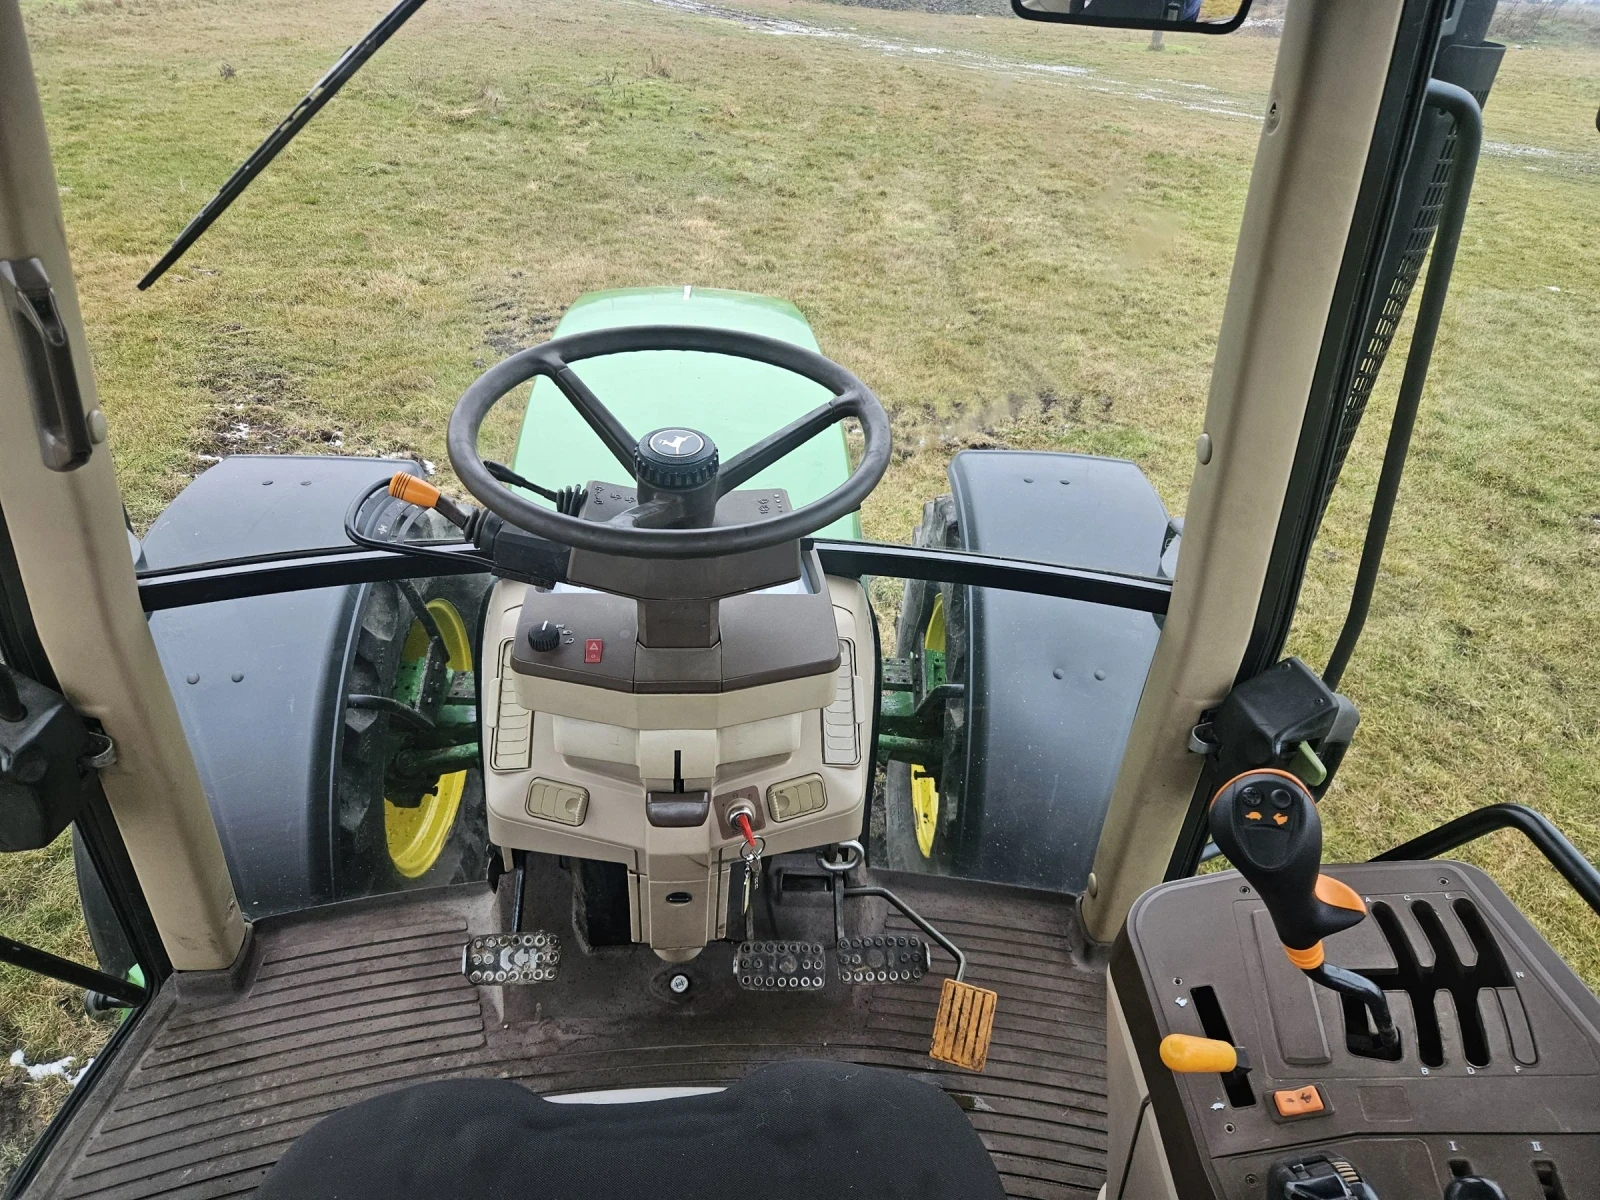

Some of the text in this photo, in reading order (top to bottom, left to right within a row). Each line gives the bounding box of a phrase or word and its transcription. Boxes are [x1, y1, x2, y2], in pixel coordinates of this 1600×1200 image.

[1420, 1067, 1429, 1075] B
[1466, 1066, 1476, 1075] D
[1514, 1065, 1522, 1073] F
